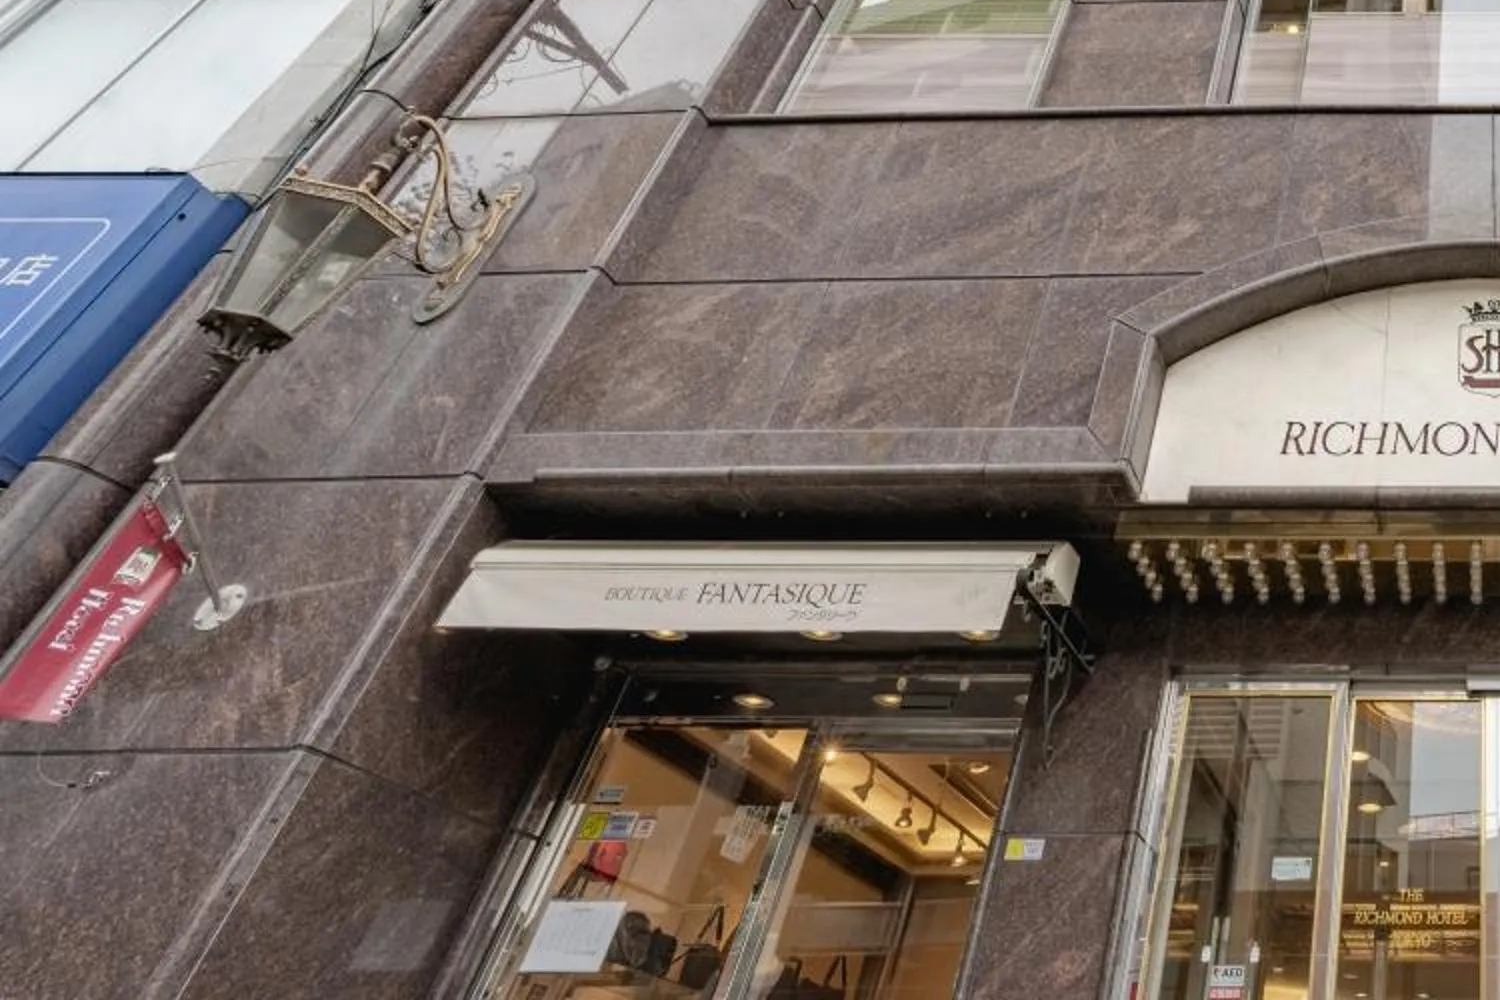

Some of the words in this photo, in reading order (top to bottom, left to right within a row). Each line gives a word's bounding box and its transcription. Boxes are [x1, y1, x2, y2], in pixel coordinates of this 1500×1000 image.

[604, 586, 688, 603] BOUTIQUE
[696, 583, 868, 608] FANTASIQUE
[1400, 888, 1424, 902] THE
[1354, 910, 1423, 925] RICHMOND
[1426, 910, 1469, 925] HOTEL
